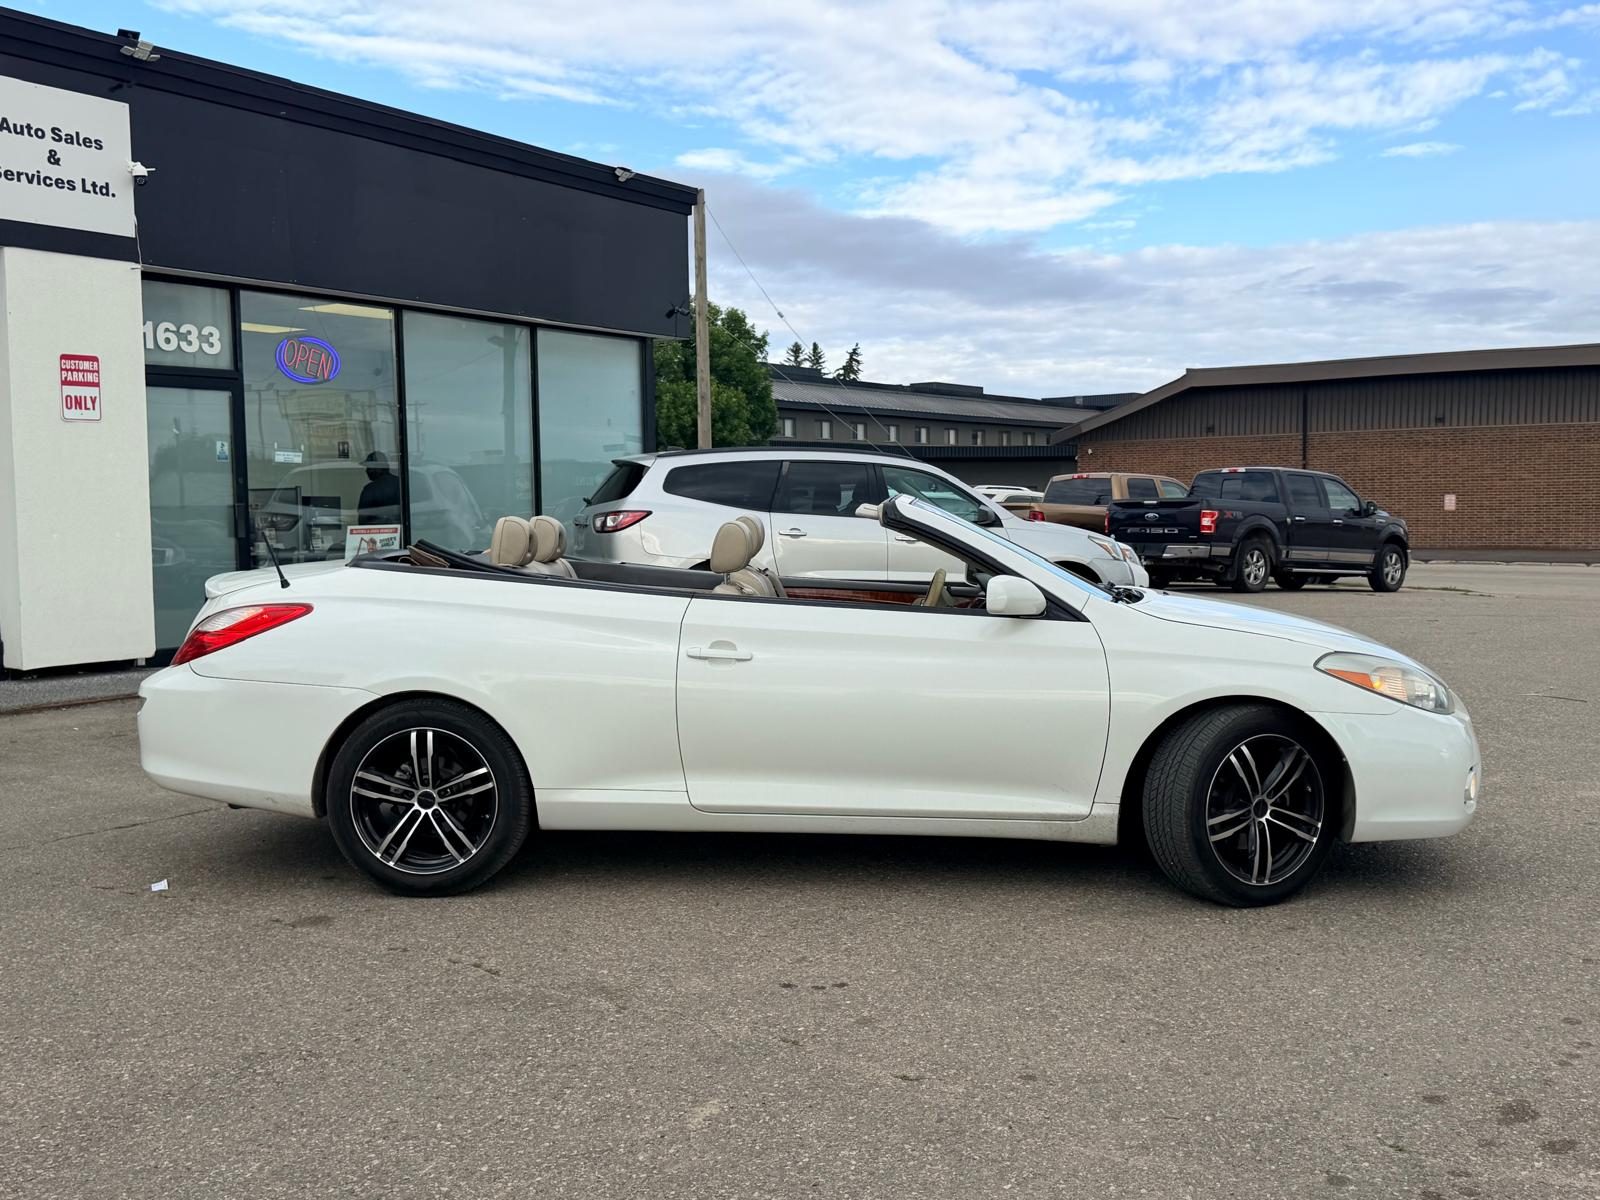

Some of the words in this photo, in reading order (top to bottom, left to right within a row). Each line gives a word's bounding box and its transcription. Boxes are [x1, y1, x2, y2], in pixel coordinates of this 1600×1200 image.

[0, 117, 46, 140] Auto
[51, 127, 103, 150] Sales
[47, 149, 61, 166] &
[0, 166, 76, 191] ervices
[81, 178, 116, 198] Ltd.
[143, 321, 221, 354] 1633
[61, 359, 98, 371] CUSTOMER
[284, 340, 332, 380] OPEN
[62, 371, 99, 383] PARKING
[65, 395, 97, 411] ONLY
